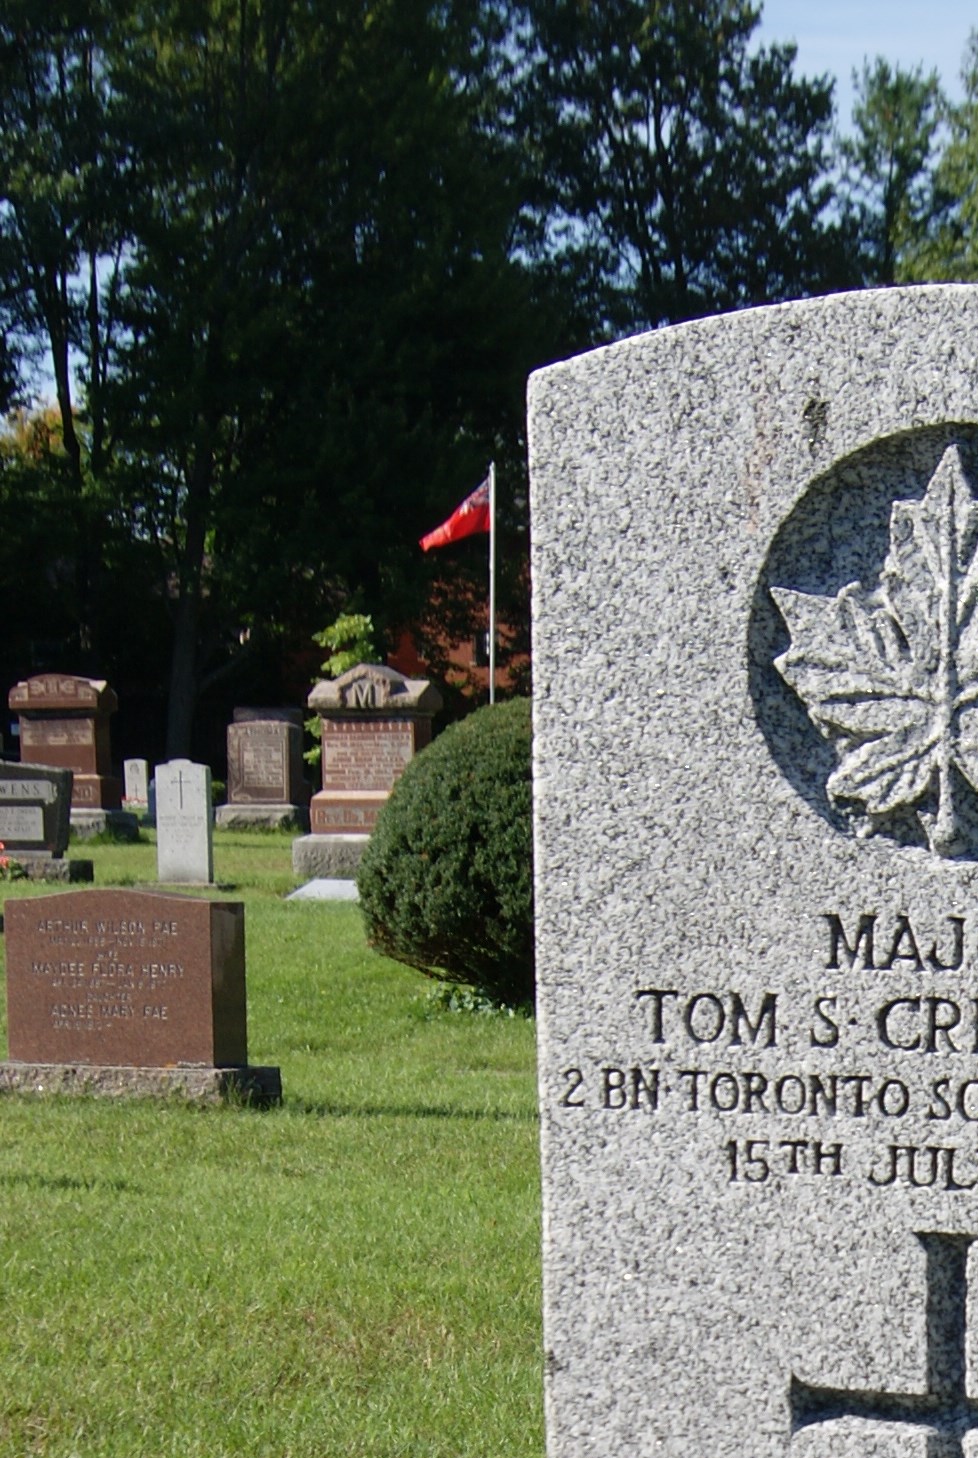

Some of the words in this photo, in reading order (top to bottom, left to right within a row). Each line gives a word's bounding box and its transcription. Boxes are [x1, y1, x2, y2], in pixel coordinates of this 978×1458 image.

[38, 920, 89, 934] ARTHUR
[96, 920, 145, 935] WILSON
[92, 962, 135, 977] FLORA
[141, 964, 184, 979] HENRY
[635, 988, 780, 1047] TOM
[560, 1067, 586, 1108] 2
[677, 1069, 909, 1118] TORONTO
[723, 1139, 844, 1183] 15TH
